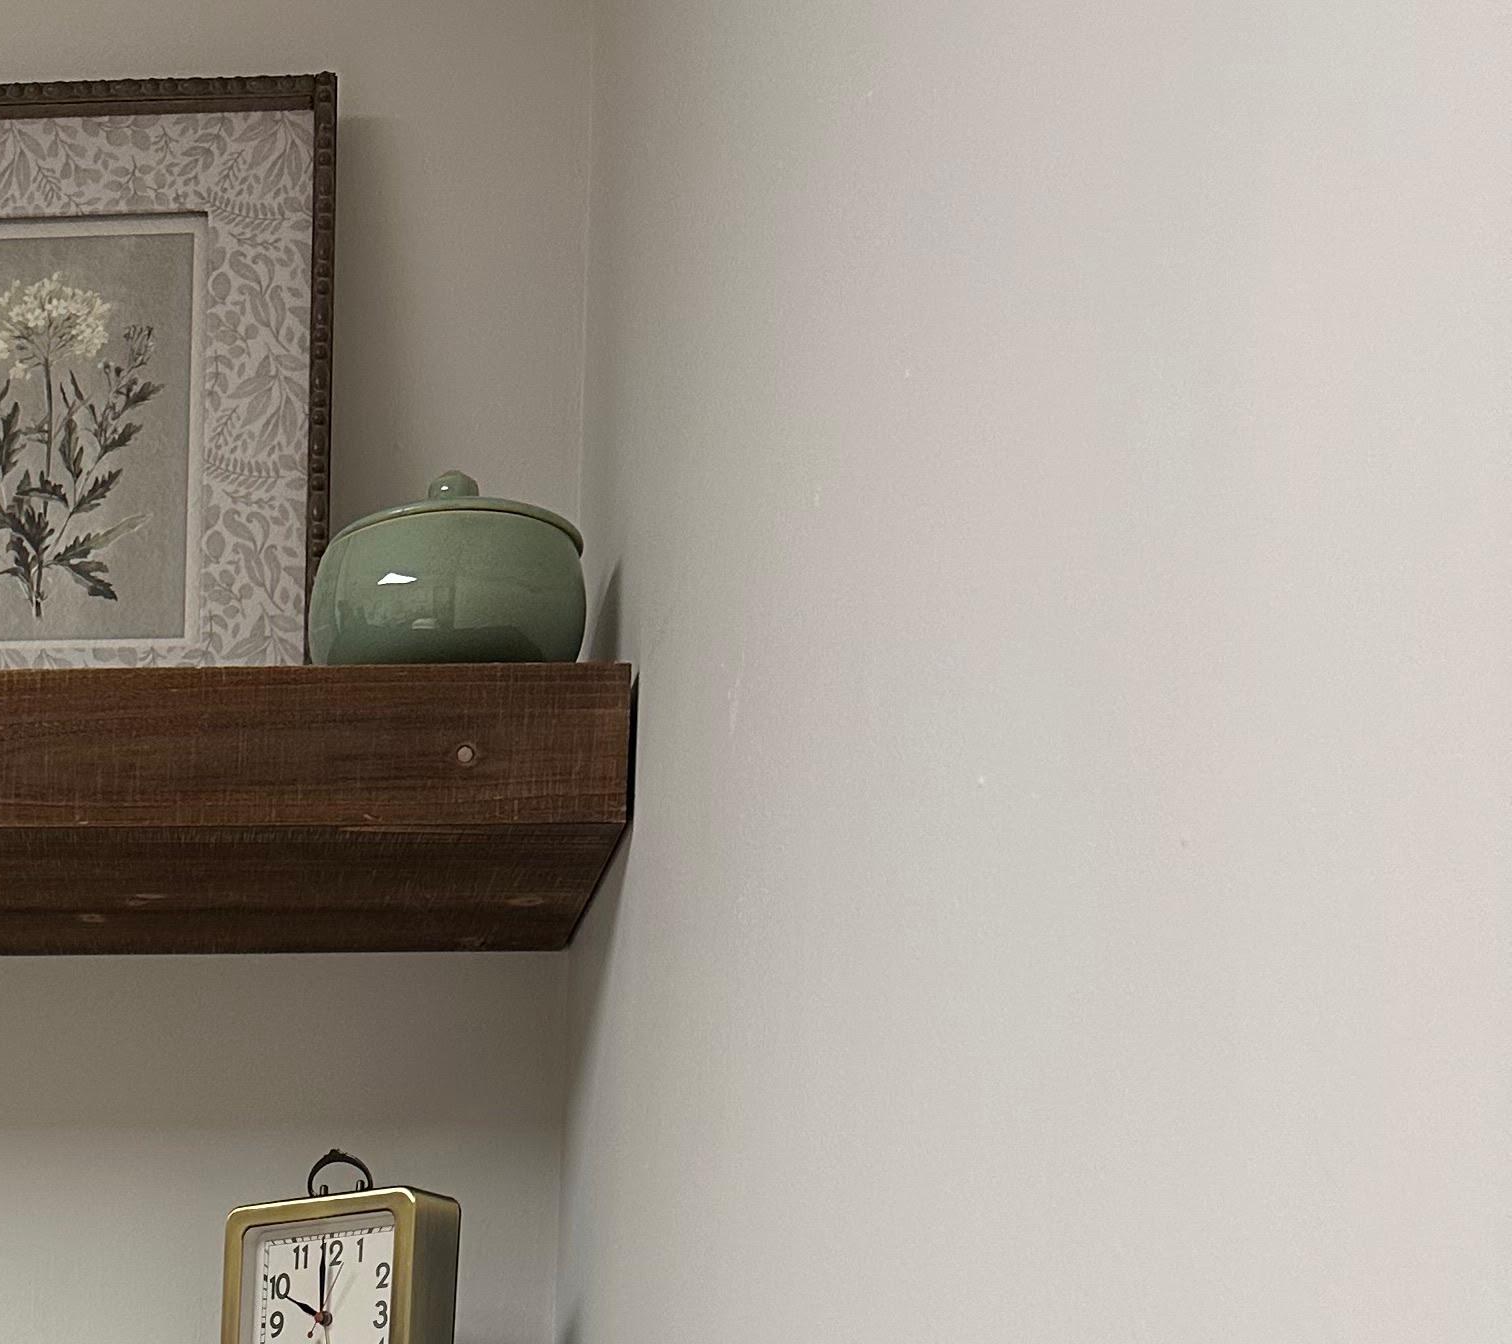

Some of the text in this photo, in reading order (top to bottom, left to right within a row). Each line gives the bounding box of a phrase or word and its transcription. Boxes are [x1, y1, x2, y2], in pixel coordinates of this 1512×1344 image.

[293, 1244, 308, 1270] 11
[320, 1240, 344, 1267] 12
[356, 1238, 364, 1262] 1
[269, 1273, 290, 1300] 10
[375, 1262, 390, 1289] 2
[270, 1311, 284, 1338] 9
[373, 1300, 388, 1329] 3
